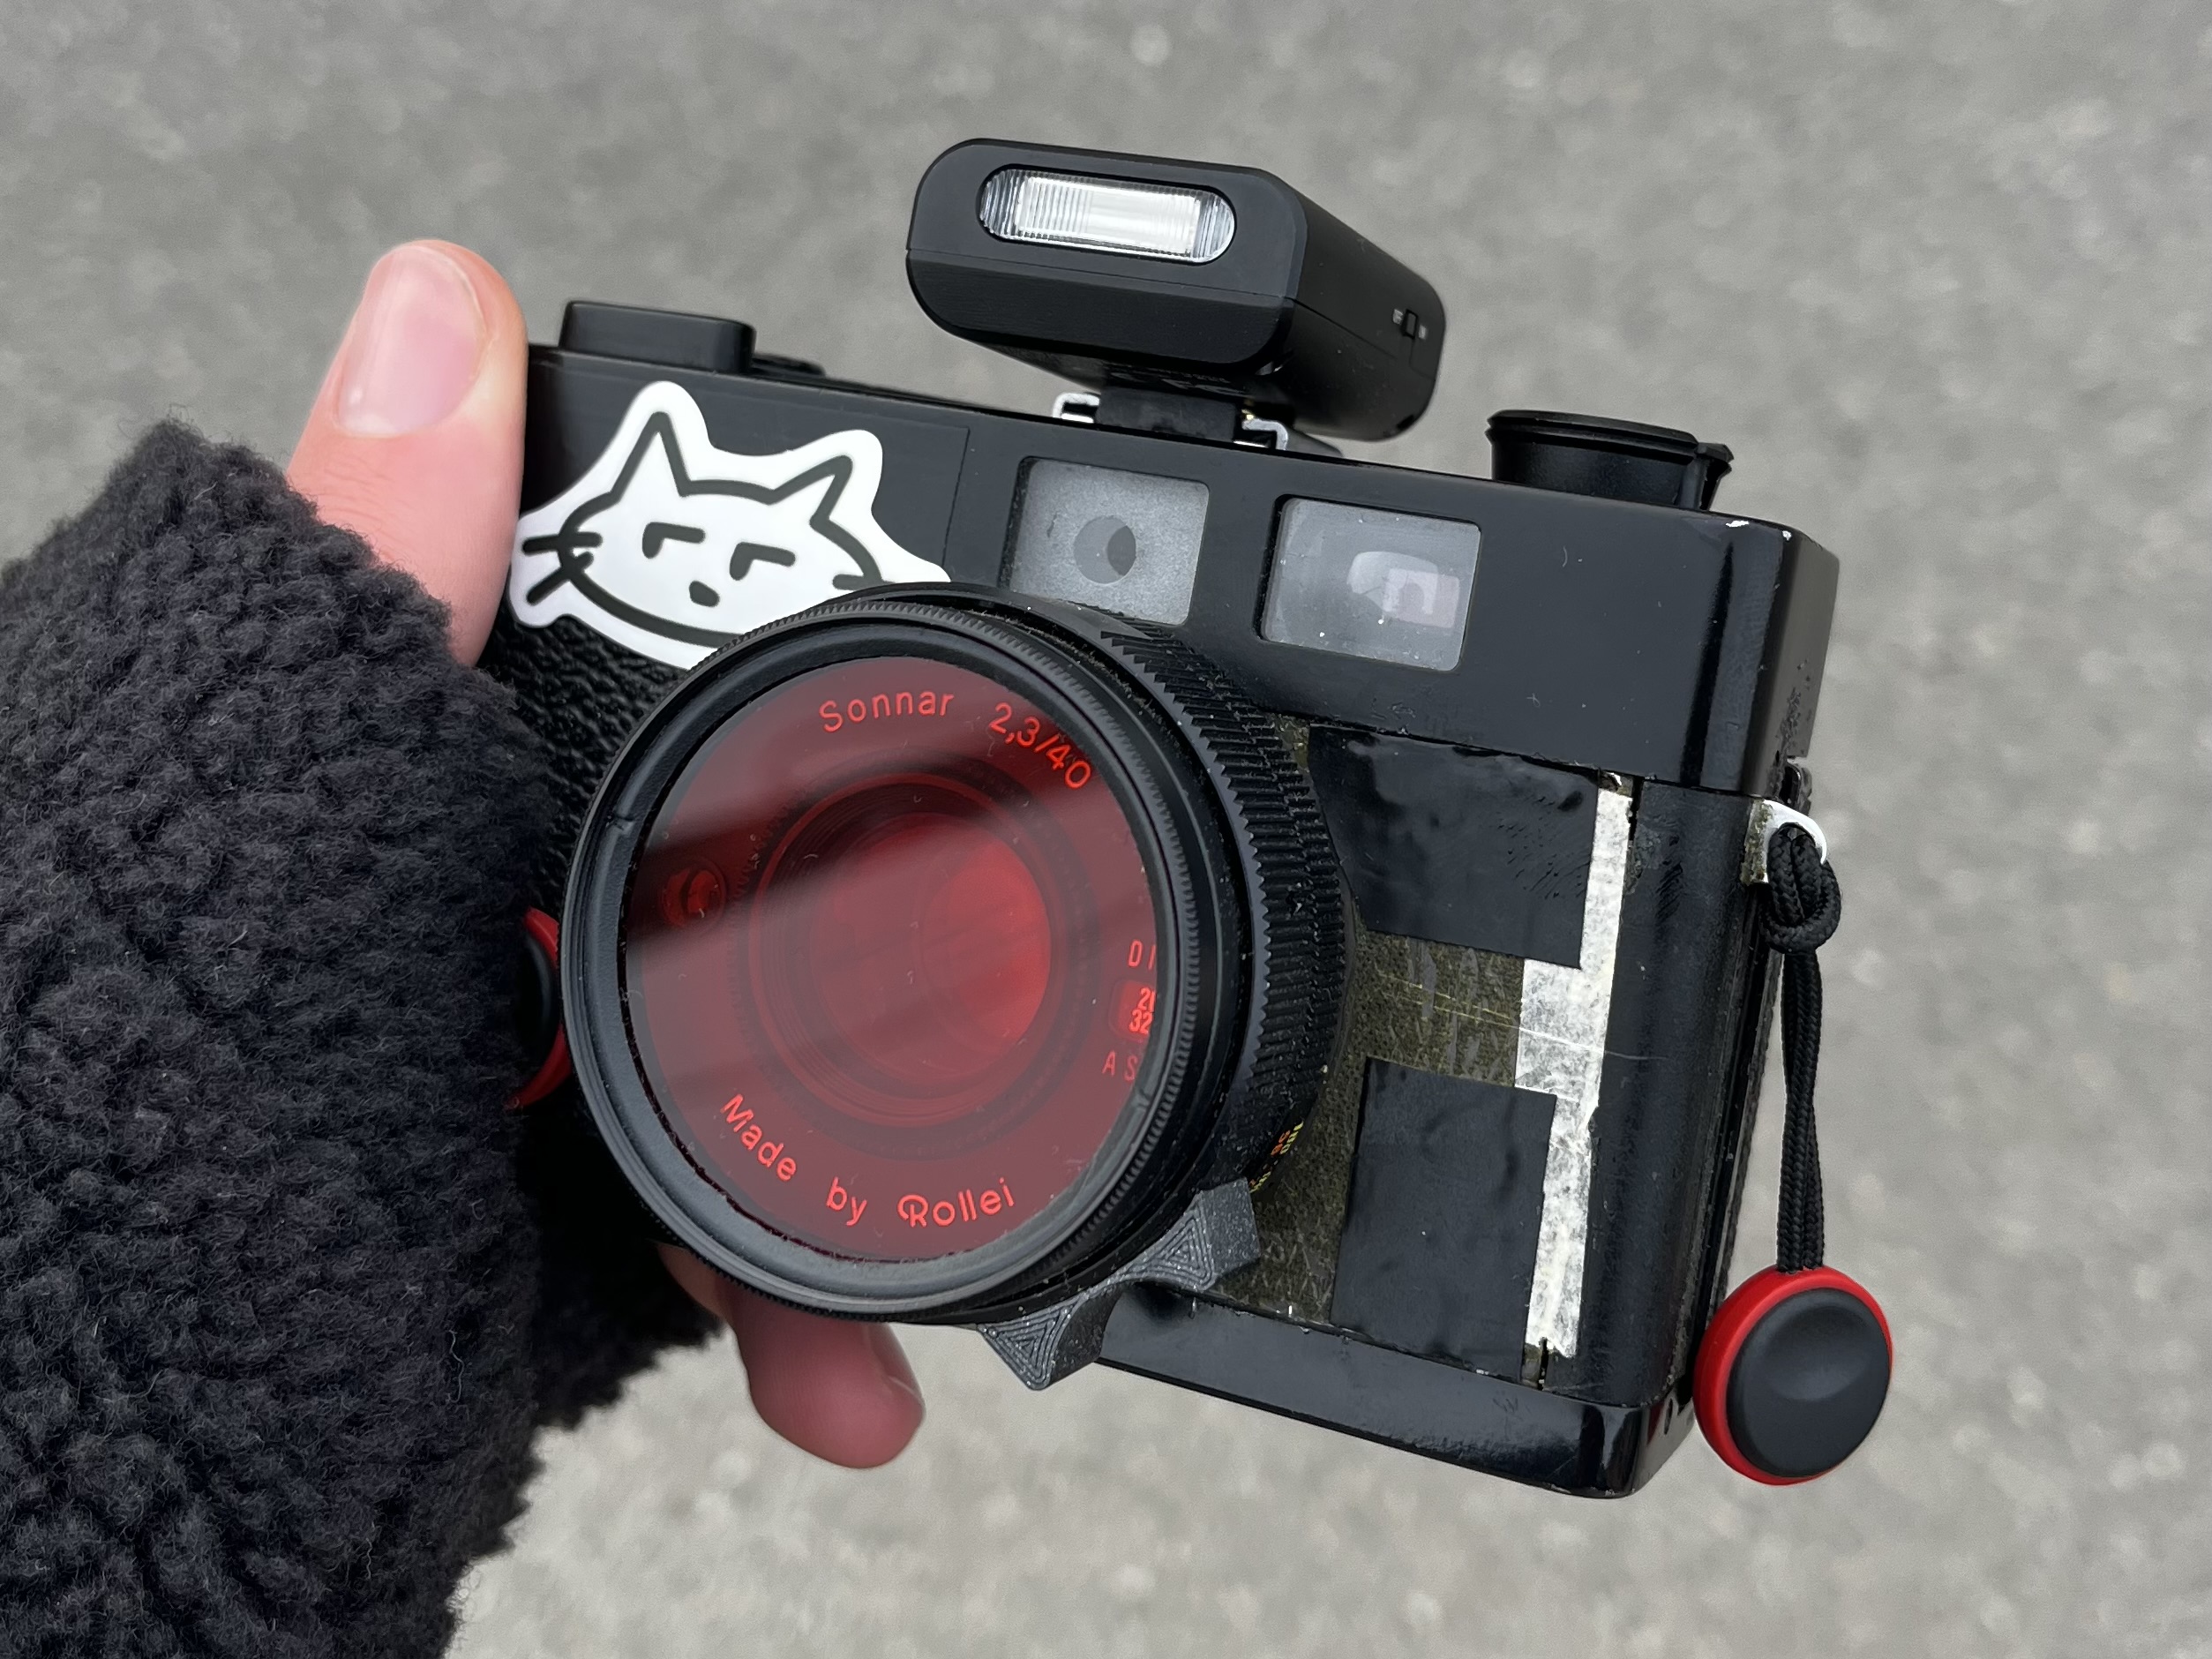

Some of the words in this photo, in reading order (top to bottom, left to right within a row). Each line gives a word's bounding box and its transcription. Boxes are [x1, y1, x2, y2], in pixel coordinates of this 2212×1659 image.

[819, 690, 955, 732] Sonnar
[989, 702, 1091, 789] 2,3/40
[1128, 1009, 1153, 1035] 32
[1137, 987, 1157, 1012] 21
[720, 1093, 797, 1182] Made
[826, 1176, 868, 1227] by
[896, 1176, 1015, 1227] Rollei
